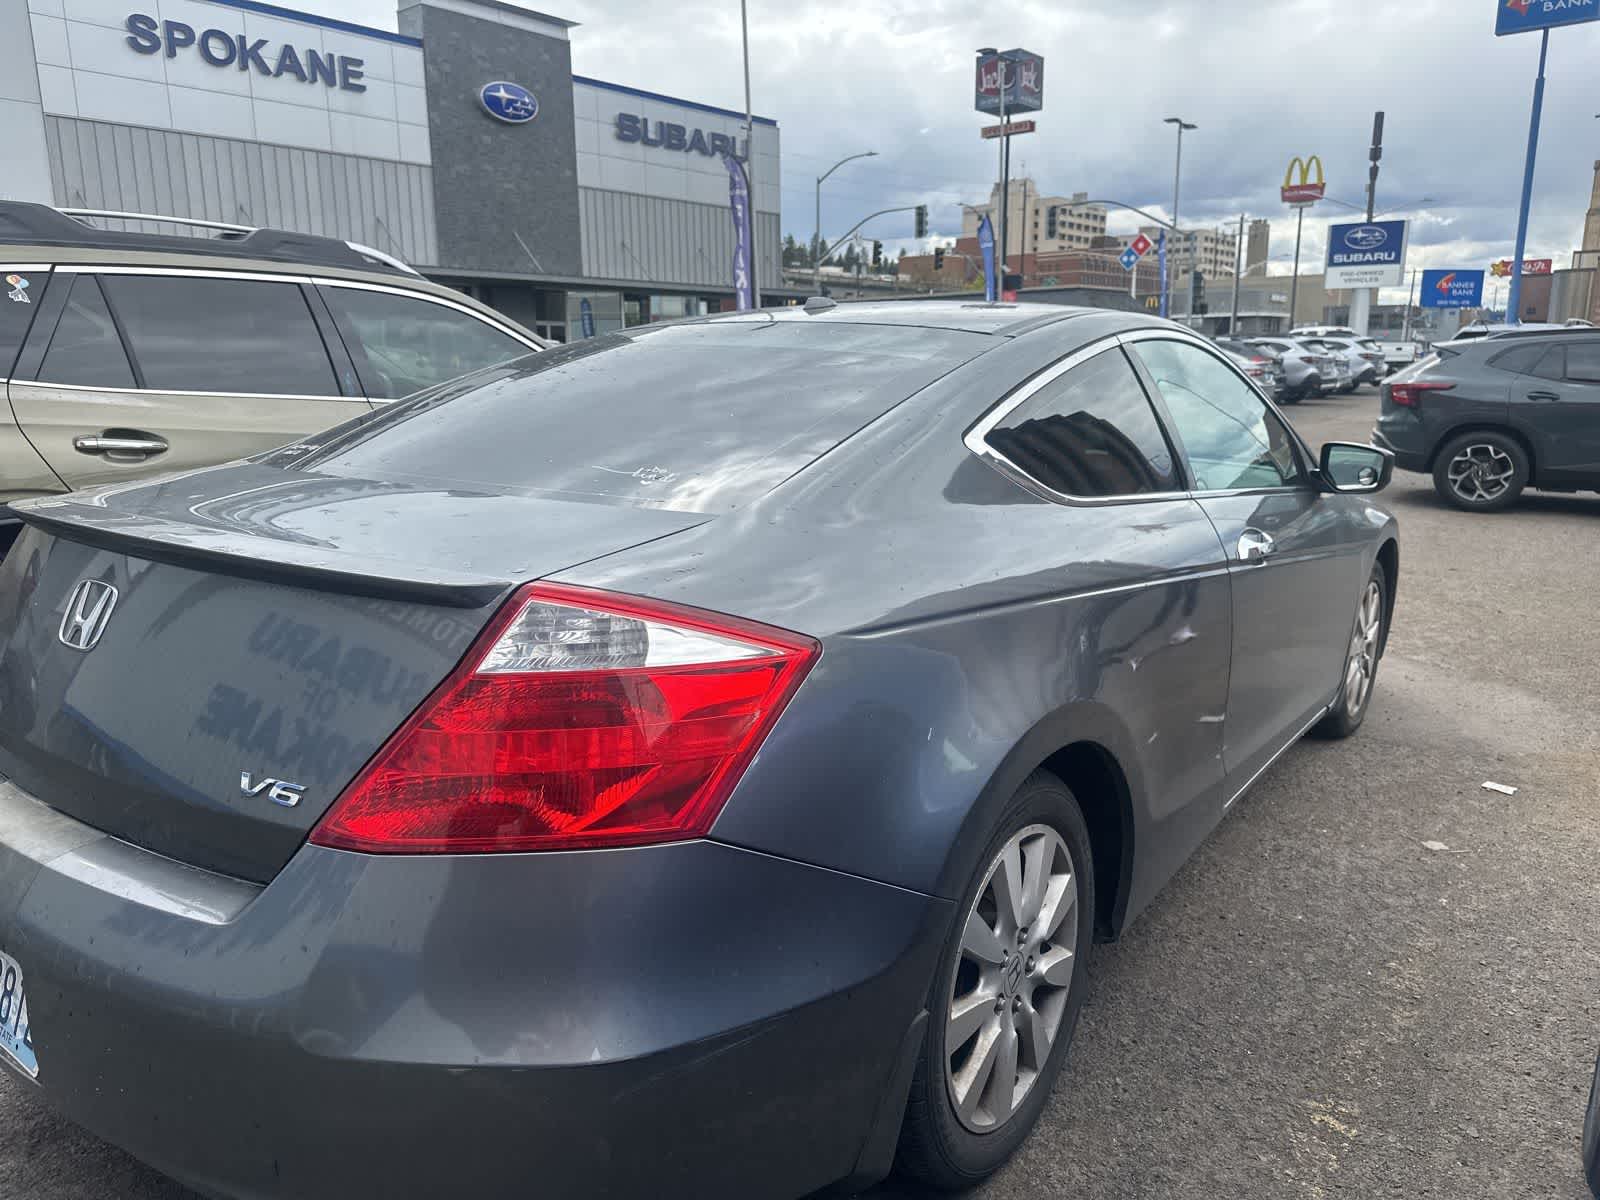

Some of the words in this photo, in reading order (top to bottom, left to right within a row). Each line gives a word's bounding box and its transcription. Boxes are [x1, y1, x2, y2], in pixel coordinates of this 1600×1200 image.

[126, 13, 366, 93] SPOKANE
[615, 112, 749, 163] SUBARU
[1333, 251, 1395, 264] SUBARU
[1441, 281, 1475, 289] BANNER
[1452, 288, 1474, 296] BANK
[240, 771, 307, 808] V6
